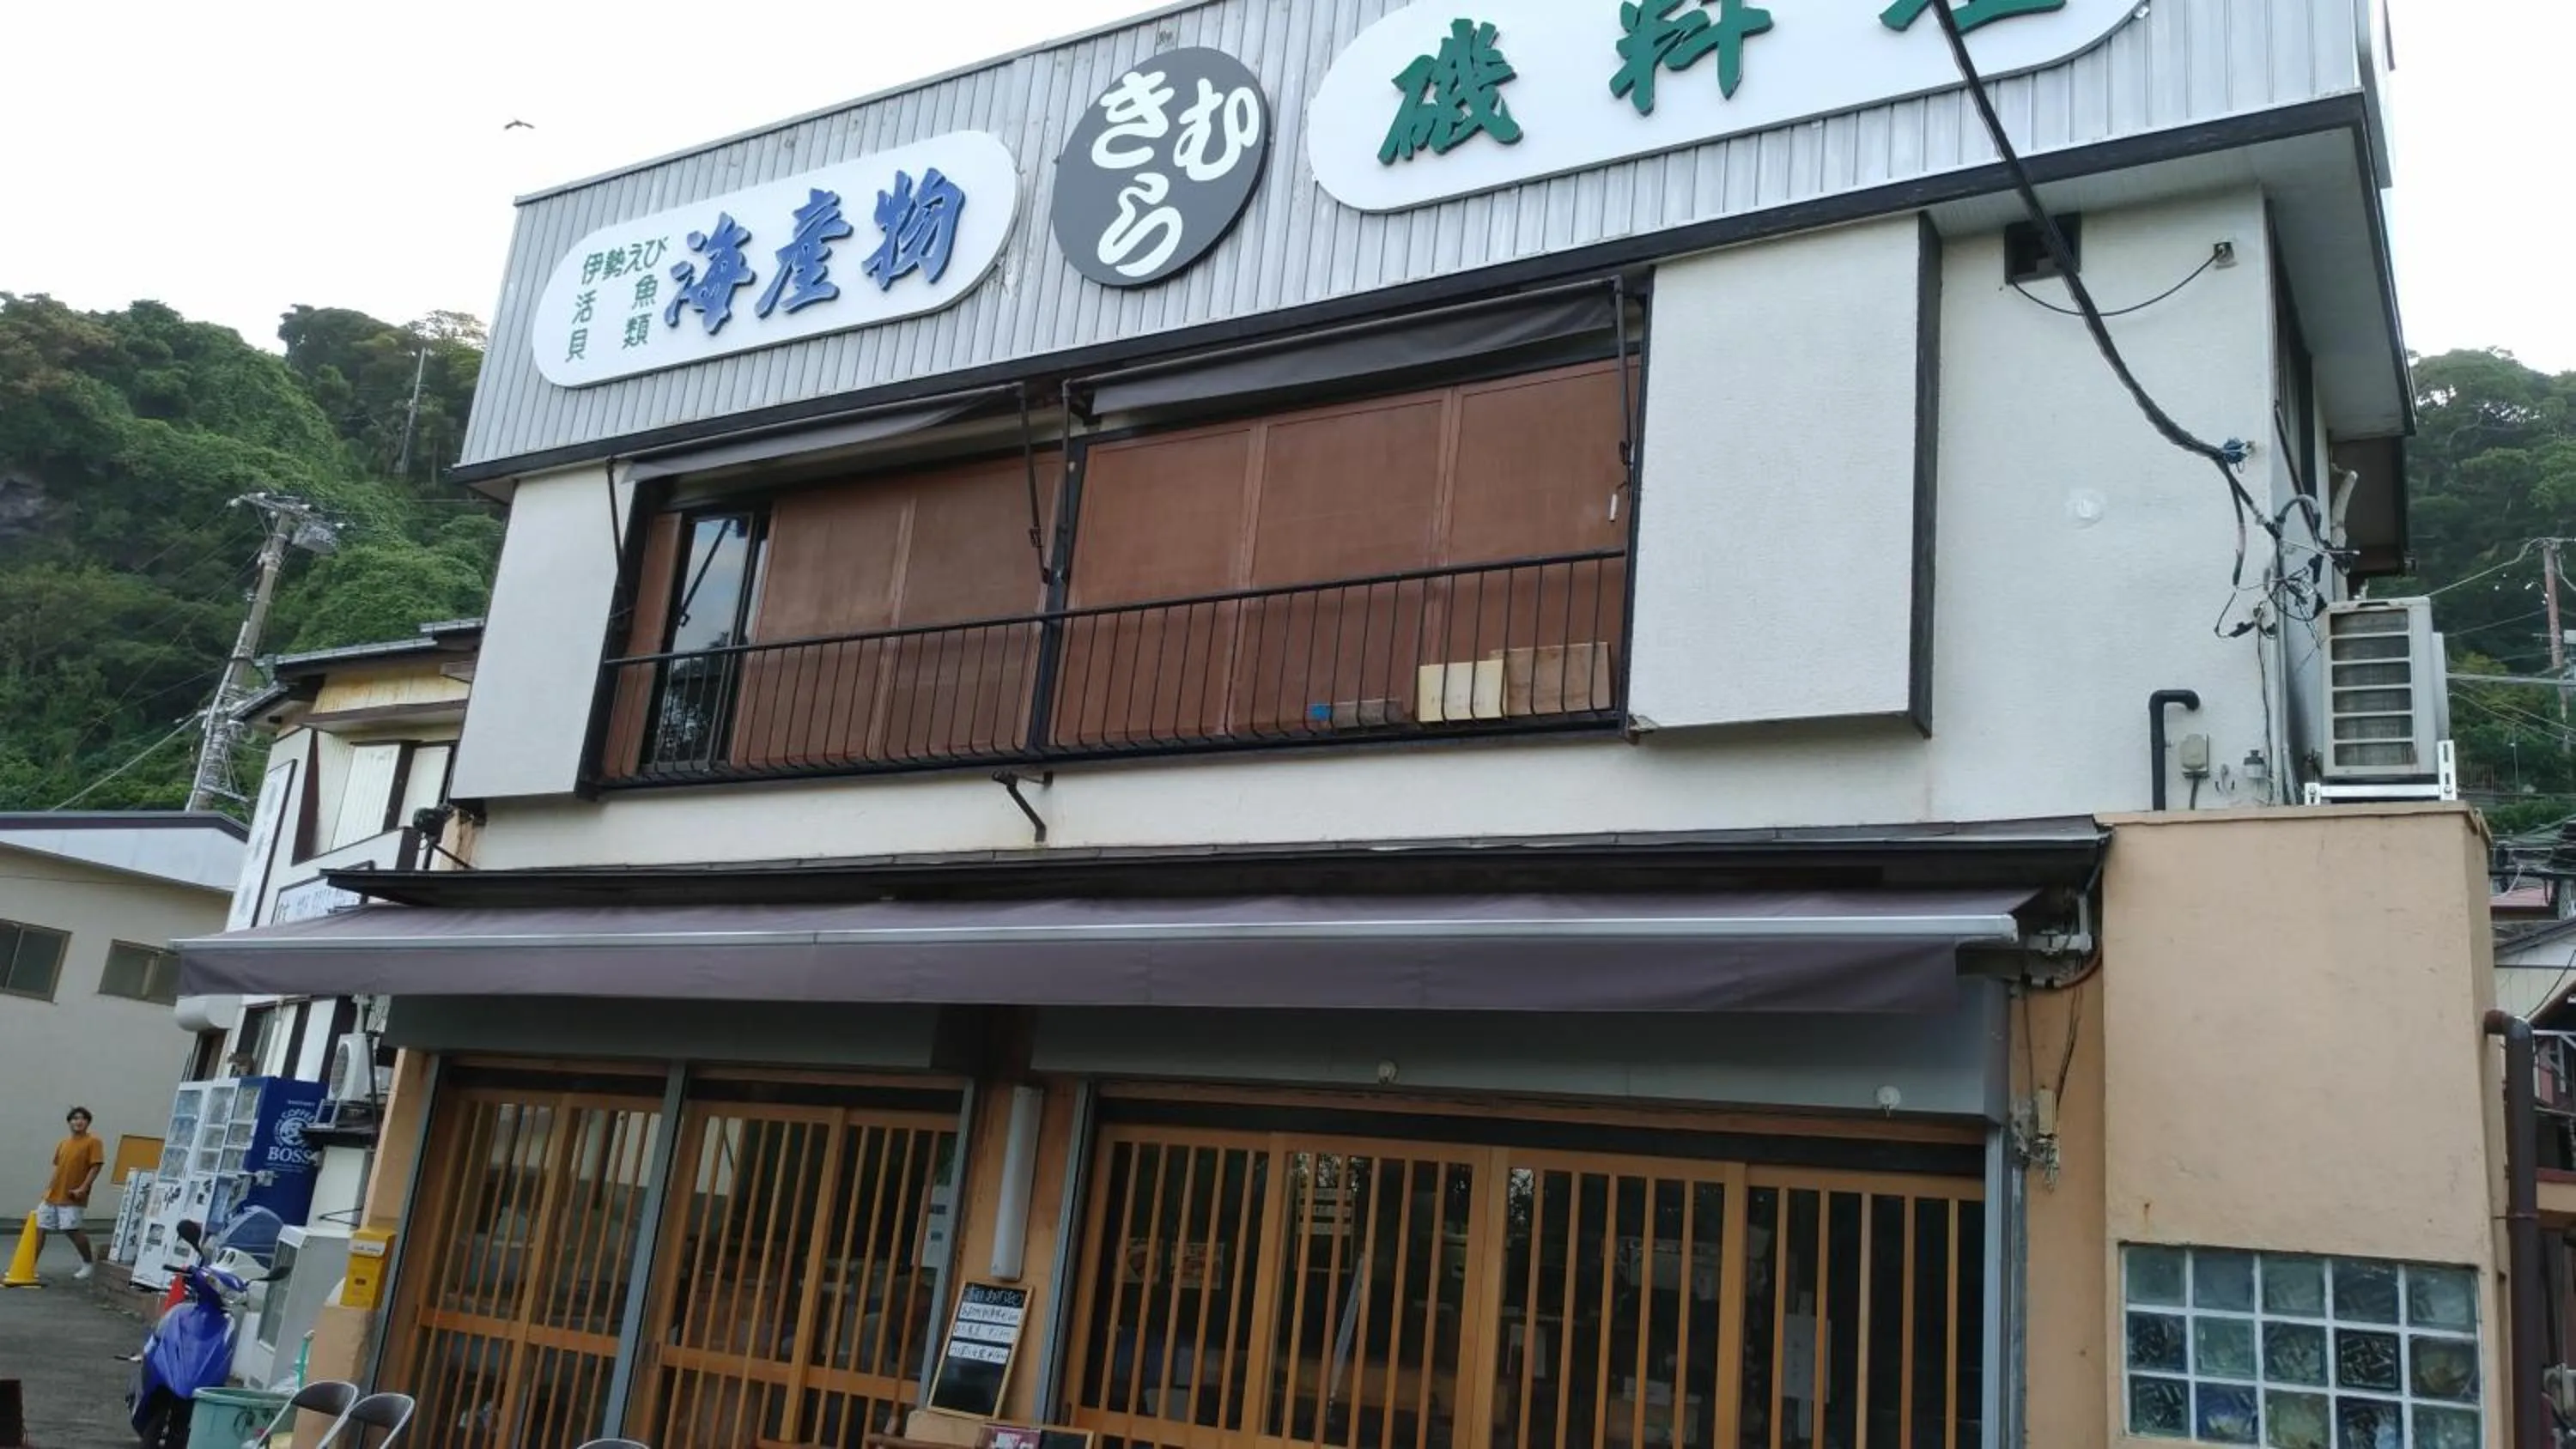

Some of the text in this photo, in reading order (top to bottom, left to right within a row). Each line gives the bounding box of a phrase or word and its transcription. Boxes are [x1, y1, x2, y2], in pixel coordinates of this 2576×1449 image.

[1377, 0, 2063, 166] 磯料
[581, 234, 670, 285] 伊勢えび
[664, 167, 966, 335] 海産物
[266, 1146, 312, 1165] BOSS
